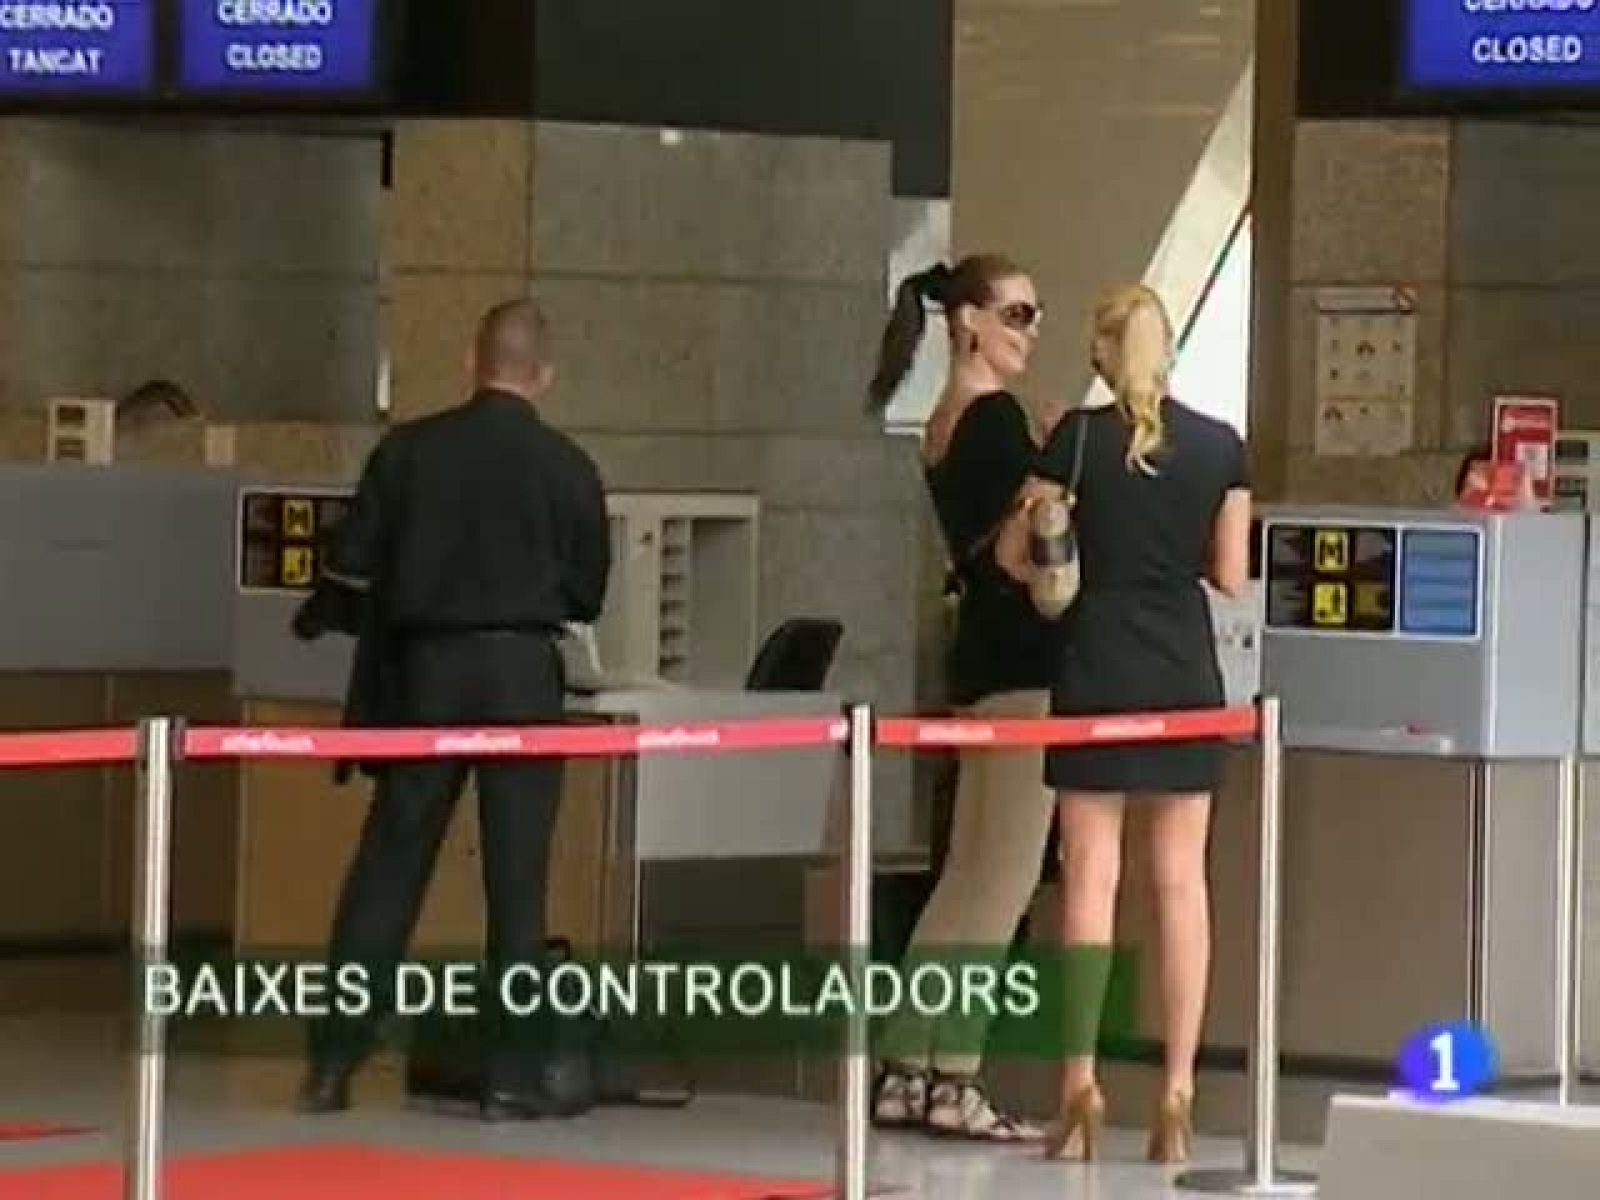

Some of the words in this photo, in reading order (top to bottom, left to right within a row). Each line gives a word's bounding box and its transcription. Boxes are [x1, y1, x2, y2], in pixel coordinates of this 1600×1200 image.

[8, 48, 104, 76] TANCAT
[226, 44, 322, 71] CLOSED
[1471, 34, 1582, 64] CLOSED
